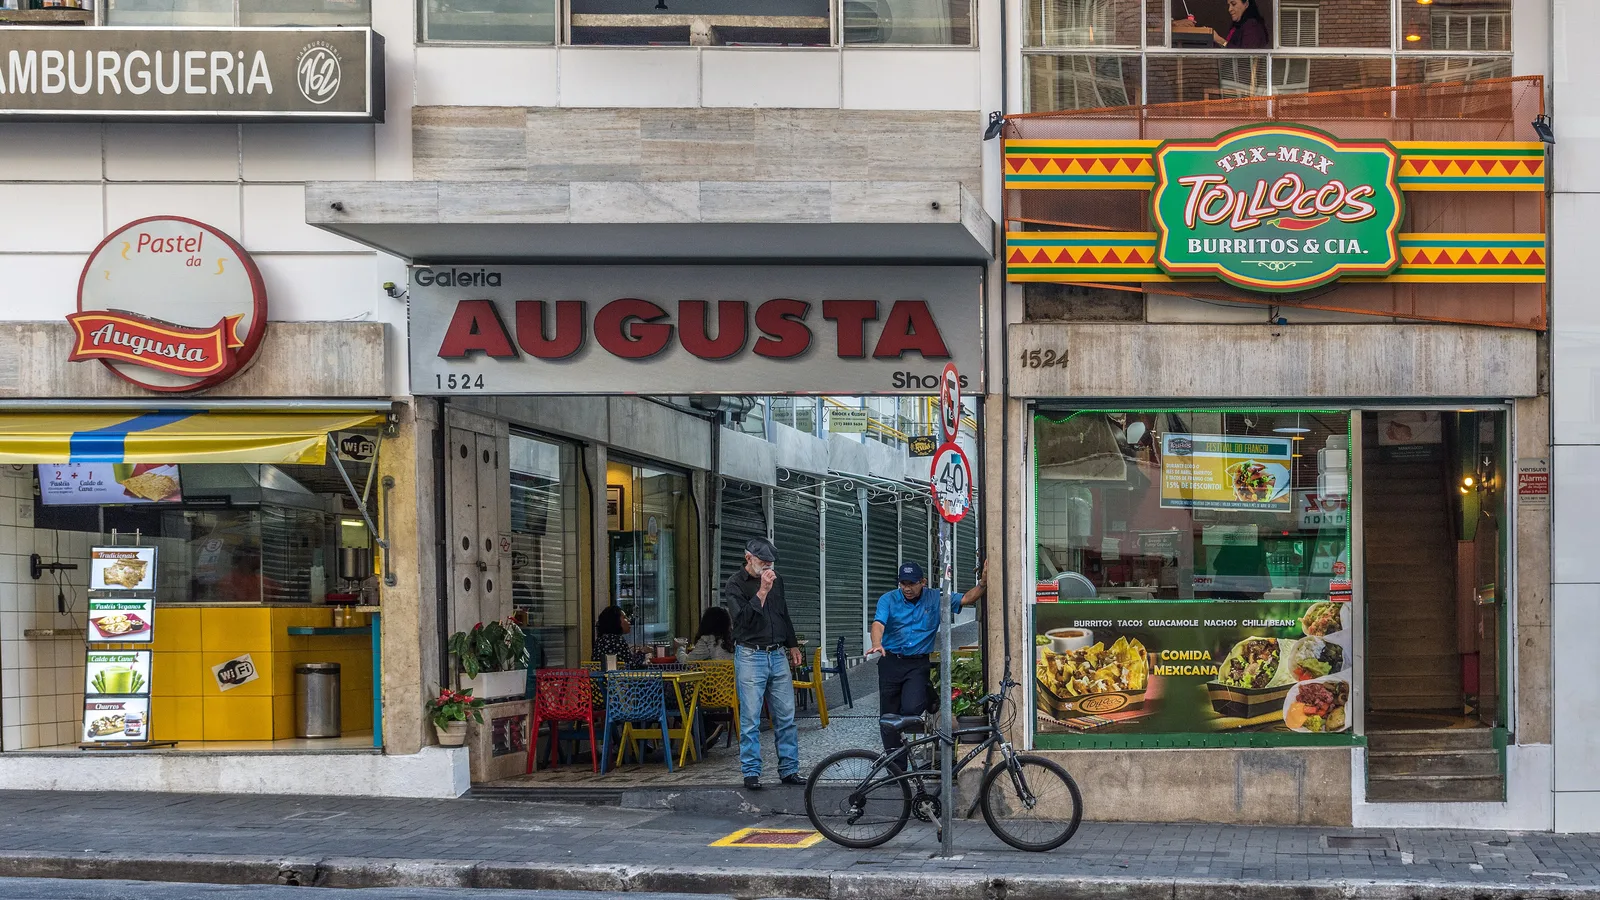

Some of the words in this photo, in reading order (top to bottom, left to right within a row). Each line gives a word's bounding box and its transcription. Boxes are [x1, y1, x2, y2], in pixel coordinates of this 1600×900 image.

[0, 49, 274, 95] MBURGUERiA
[301, 52, 338, 96] 162
[1216, 146, 1334, 175] TEX-MEX
[1177, 172, 1377, 232] TOLLOCOS
[137, 231, 203, 253] Pastel
[1188, 238, 1299, 254] BURRITOS
[1302, 238, 1320, 254] &
[1324, 238, 1369, 254] CIA.
[186, 255, 202, 267] da
[415, 268, 502, 287] Galeria
[437, 297, 953, 361] AUGUSTA
[90, 322, 208, 363] Augusta
[1020, 347, 1070, 369] 1524
[436, 374, 484, 389] 1524
[892, 371, 969, 389] Shos
[1206, 442, 1233, 452] FESTIVAL
[1234, 443, 1242, 453] DO
[1244, 444, 1269, 454] FRANGO!
[56, 471, 62, 480] 2
[88, 471, 93, 480] 1
[940, 462, 964, 493] 40
[1520, 474, 1548, 482] Alarme
[1190, 482, 1222, 490] DESCONTO!
[1073, 619, 1112, 628] BURRITOS
[1117, 619, 1143, 628] TACOS
[1148, 619, 1199, 628] GUACAMOLE
[1204, 619, 1238, 628] NACHOS
[1270, 619, 1296, 628] BEANS
[1161, 650, 1212, 661] COMIDA
[1154, 664, 1219, 676] MEXICANA
